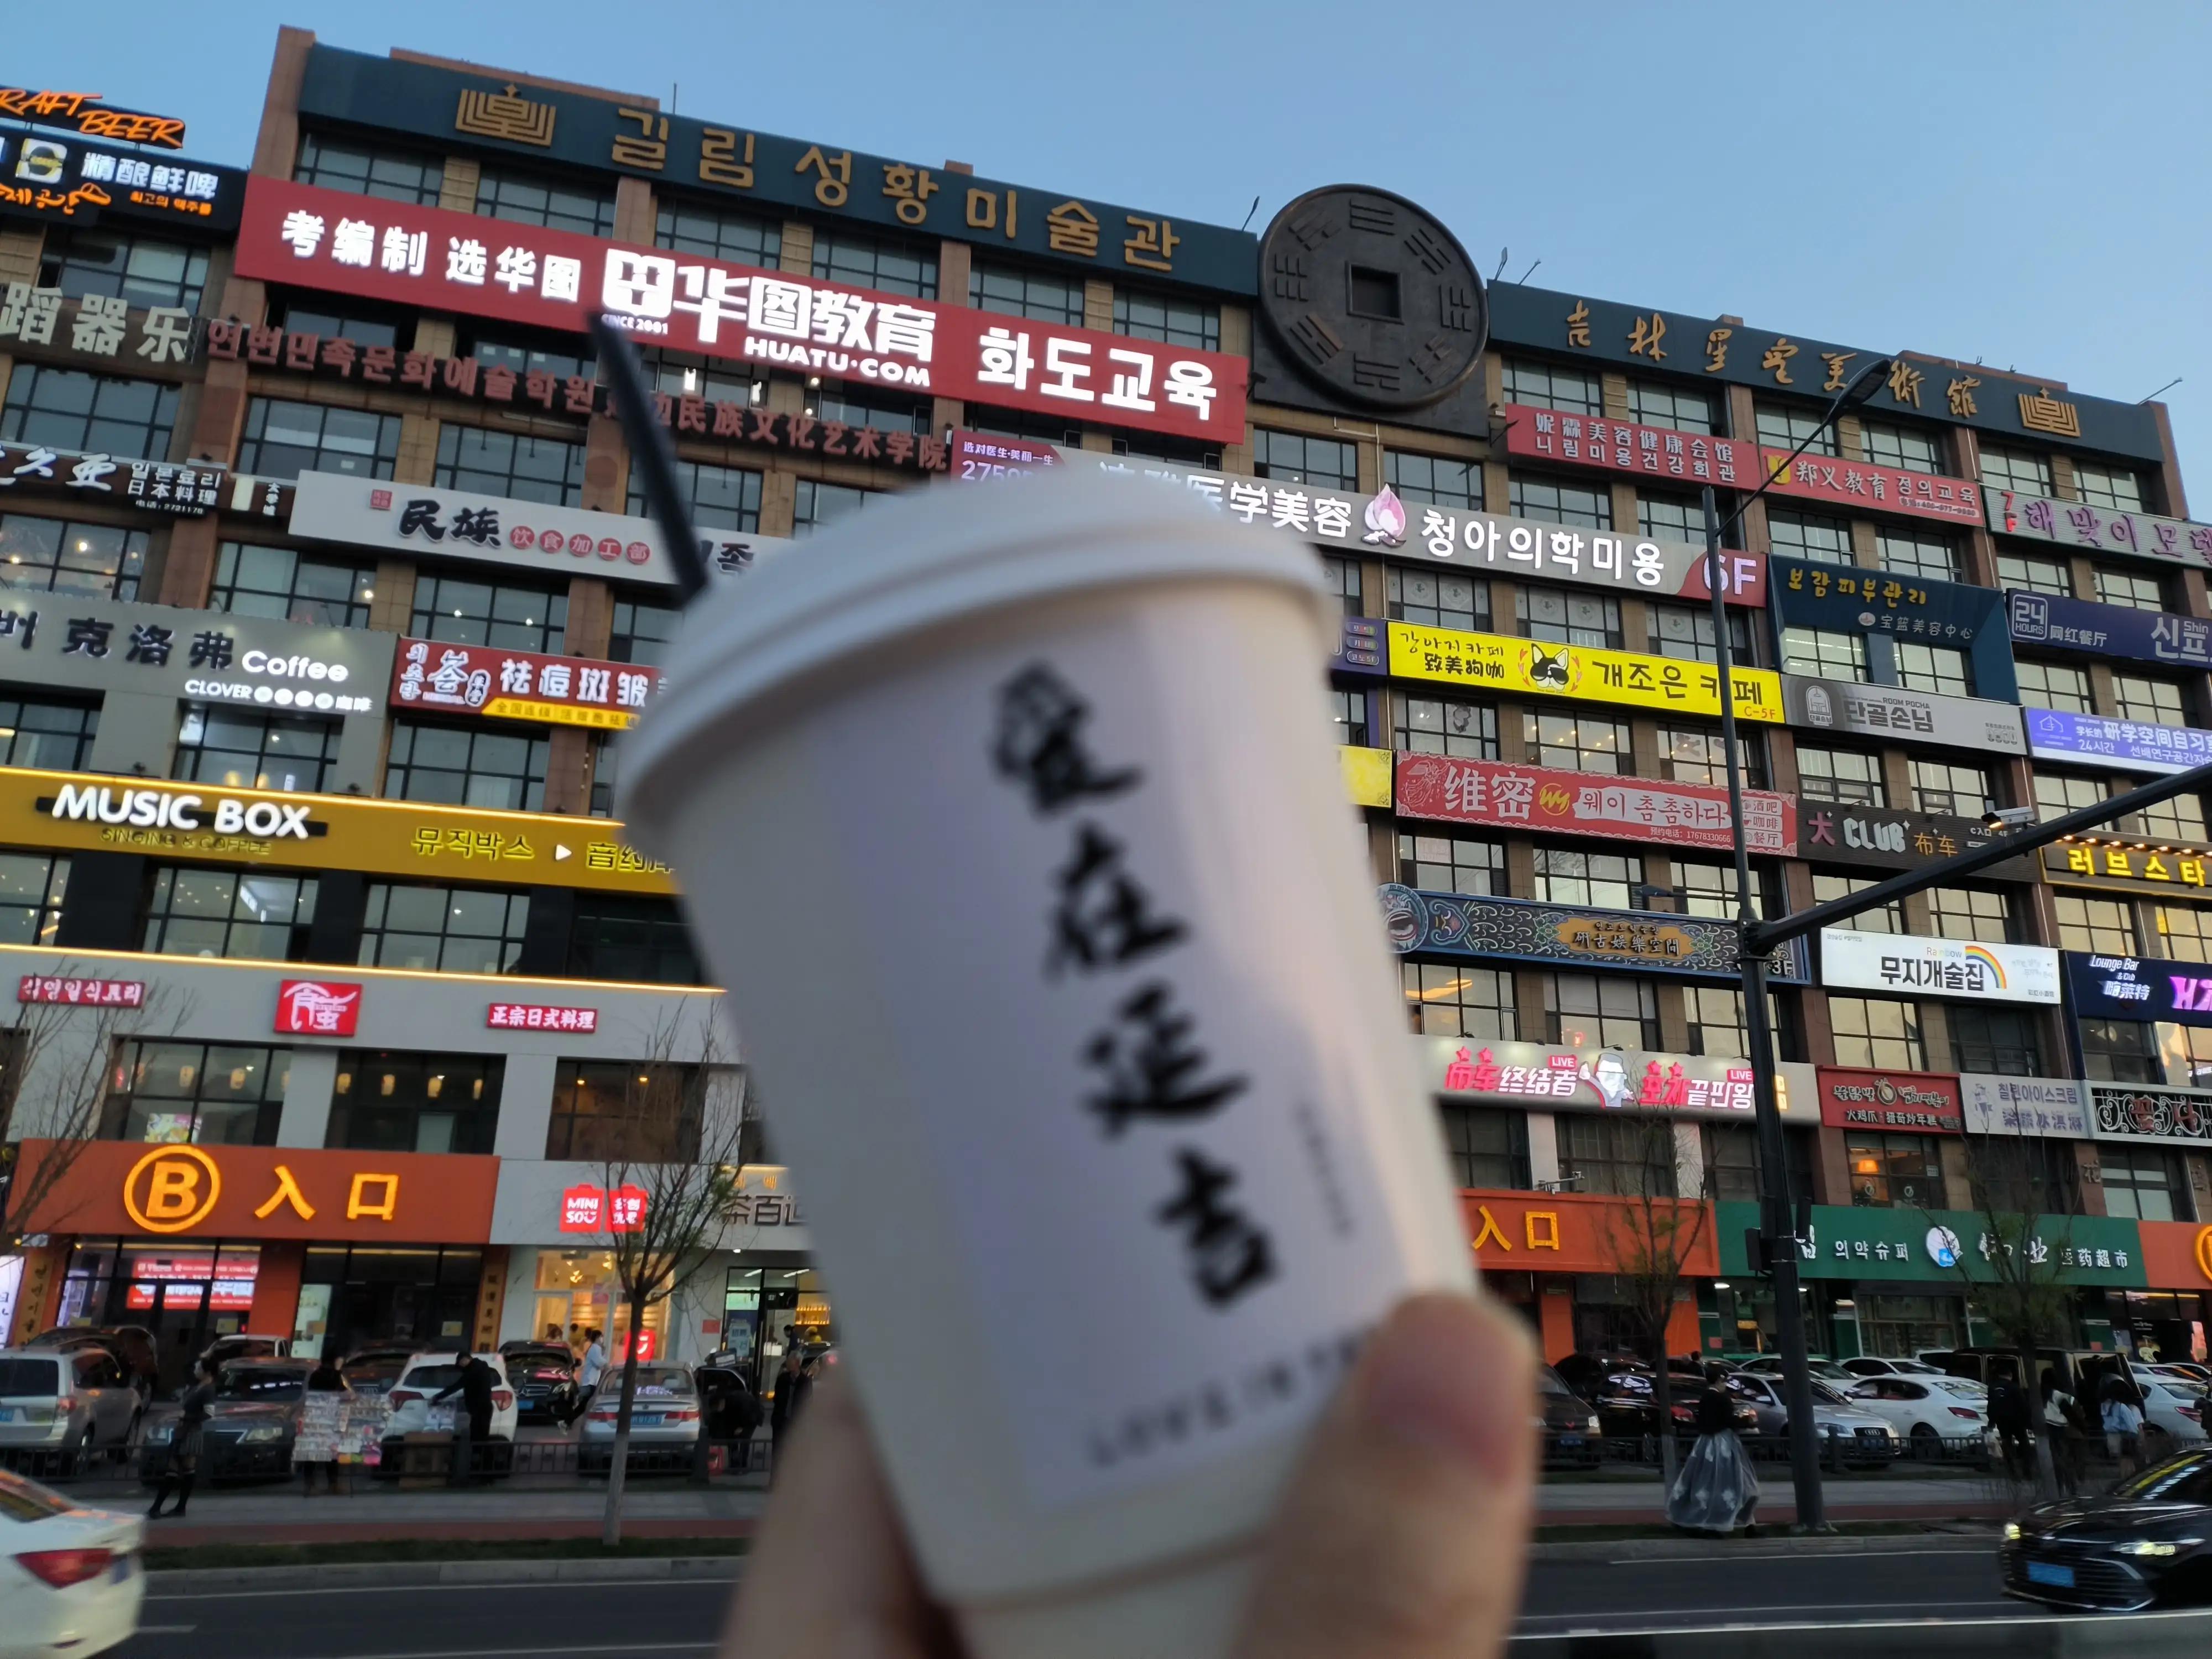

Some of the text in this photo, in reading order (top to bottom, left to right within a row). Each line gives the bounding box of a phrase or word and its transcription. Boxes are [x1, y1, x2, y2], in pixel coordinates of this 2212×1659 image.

[79, 111, 185, 148] BEER
[81, 152, 219, 199] 精酿鲜啤
[281, 210, 581, 302] 考编制 选华图
[1, 281, 191, 363] 蹈器乐
[673, 265, 936, 362] 华图教育
[977, 326, 1217, 420] 화도교육
[1536, 436, 1736, 483] 니림미용건강회관
[131, 462, 221, 489] 일본료리
[1795, 460, 1887, 500] 郑义教育
[128, 479, 217, 506] 日本料理
[1897, 475, 1976, 507] 정의교육
[398, 499, 502, 549] 民族
[510, 526, 650, 565] 饮食加工部
[1421, 509, 1665, 586] 청아의학미용
[2016, 601, 2044, 625] 24
[2184, 620, 2209, 634] Shin
[62, 617, 234, 671] 克洛弗
[2015, 623, 2044, 635] HOURS
[2050, 625, 2107, 648] 网红餐厅
[242, 650, 349, 682] Coffee
[185, 680, 253, 699] CLOVER
[1882, 697, 1904, 706] ROOM
[1905, 700, 1931, 709] POCHA
[1744, 706, 1776, 720] C-5F
[1843, 701, 1934, 733] 단골손님
[2078, 739, 2115, 754] 24시간
[1443, 766, 1536, 820] 维密
[1583, 789, 1626, 819] 웨이
[1752, 800, 1778, 813] 酒吧
[53, 784, 311, 839] MUSIC BOX
[1753, 816, 1778, 830] 咖啡
[100, 827, 272, 855] SINGING & COFFEE
[411, 827, 535, 860] 뮤직박스
[1754, 832, 1778, 846] 餐厅
[1808, 812, 1835, 846] 大
[1843, 817, 1907, 853] CLUB
[1914, 832, 1958, 858] 布车
[2068, 847, 2205, 887] 러브스타
[1772, 959, 1793, 975] 3F
[1927, 946, 1963, 958] Rainbow
[2089, 955, 2140, 972] Lounge Bar
[1881, 956, 1985, 992] 무지개술집
[490, 1005, 595, 1030] 正宗日式料理
[1552, 1056, 1575, 1068] LIVE
[1731, 1070, 1752, 1080] LIVE
[1847, 1109, 1878, 1123] 火鸡爪
[254, 1165, 399, 1222] 入口
[566, 1197, 599, 1209] MINI
[1472, 1205, 1560, 1251] 入口
[2061, 1248, 2128, 1268] 医药超市
